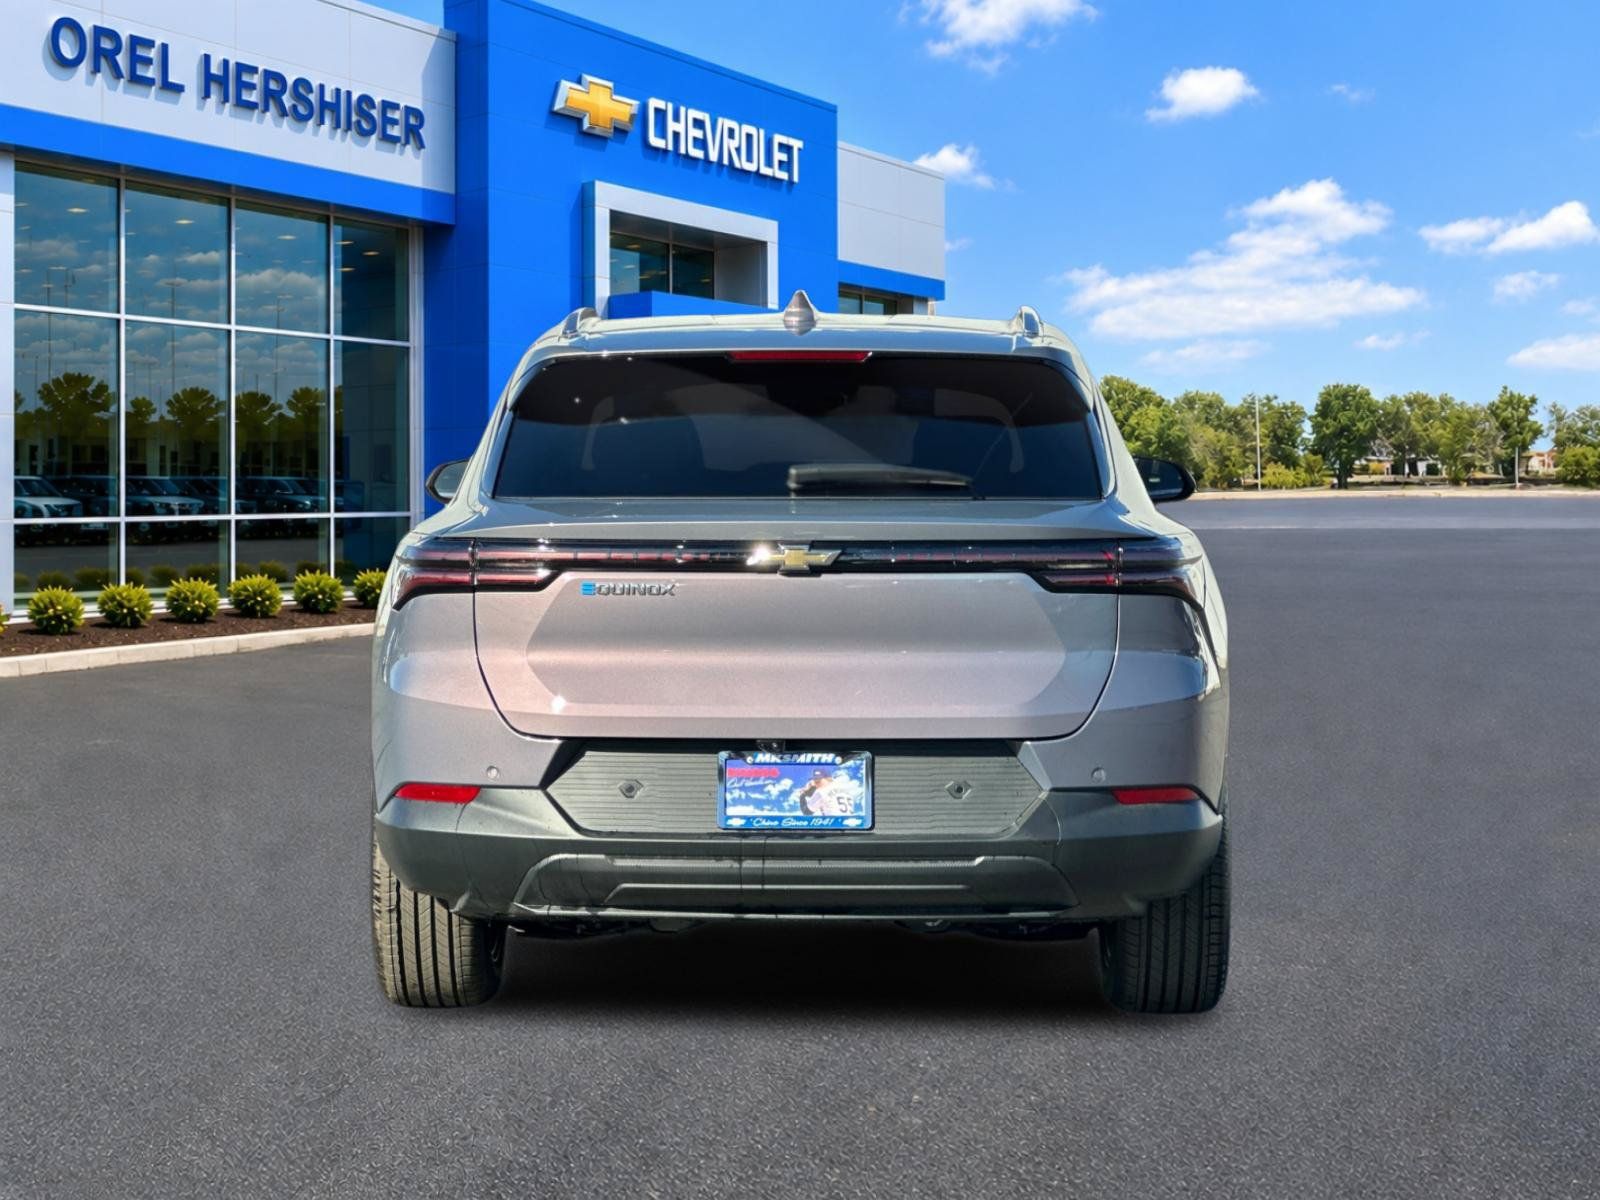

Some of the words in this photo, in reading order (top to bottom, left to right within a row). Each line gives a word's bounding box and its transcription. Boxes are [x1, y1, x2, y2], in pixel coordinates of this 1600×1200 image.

[49, 16, 185, 93] OREL
[201, 53, 425, 149] HERSHISER
[648, 97, 804, 183] CHEVROLET
[581, 582, 676, 596] EQUINOX
